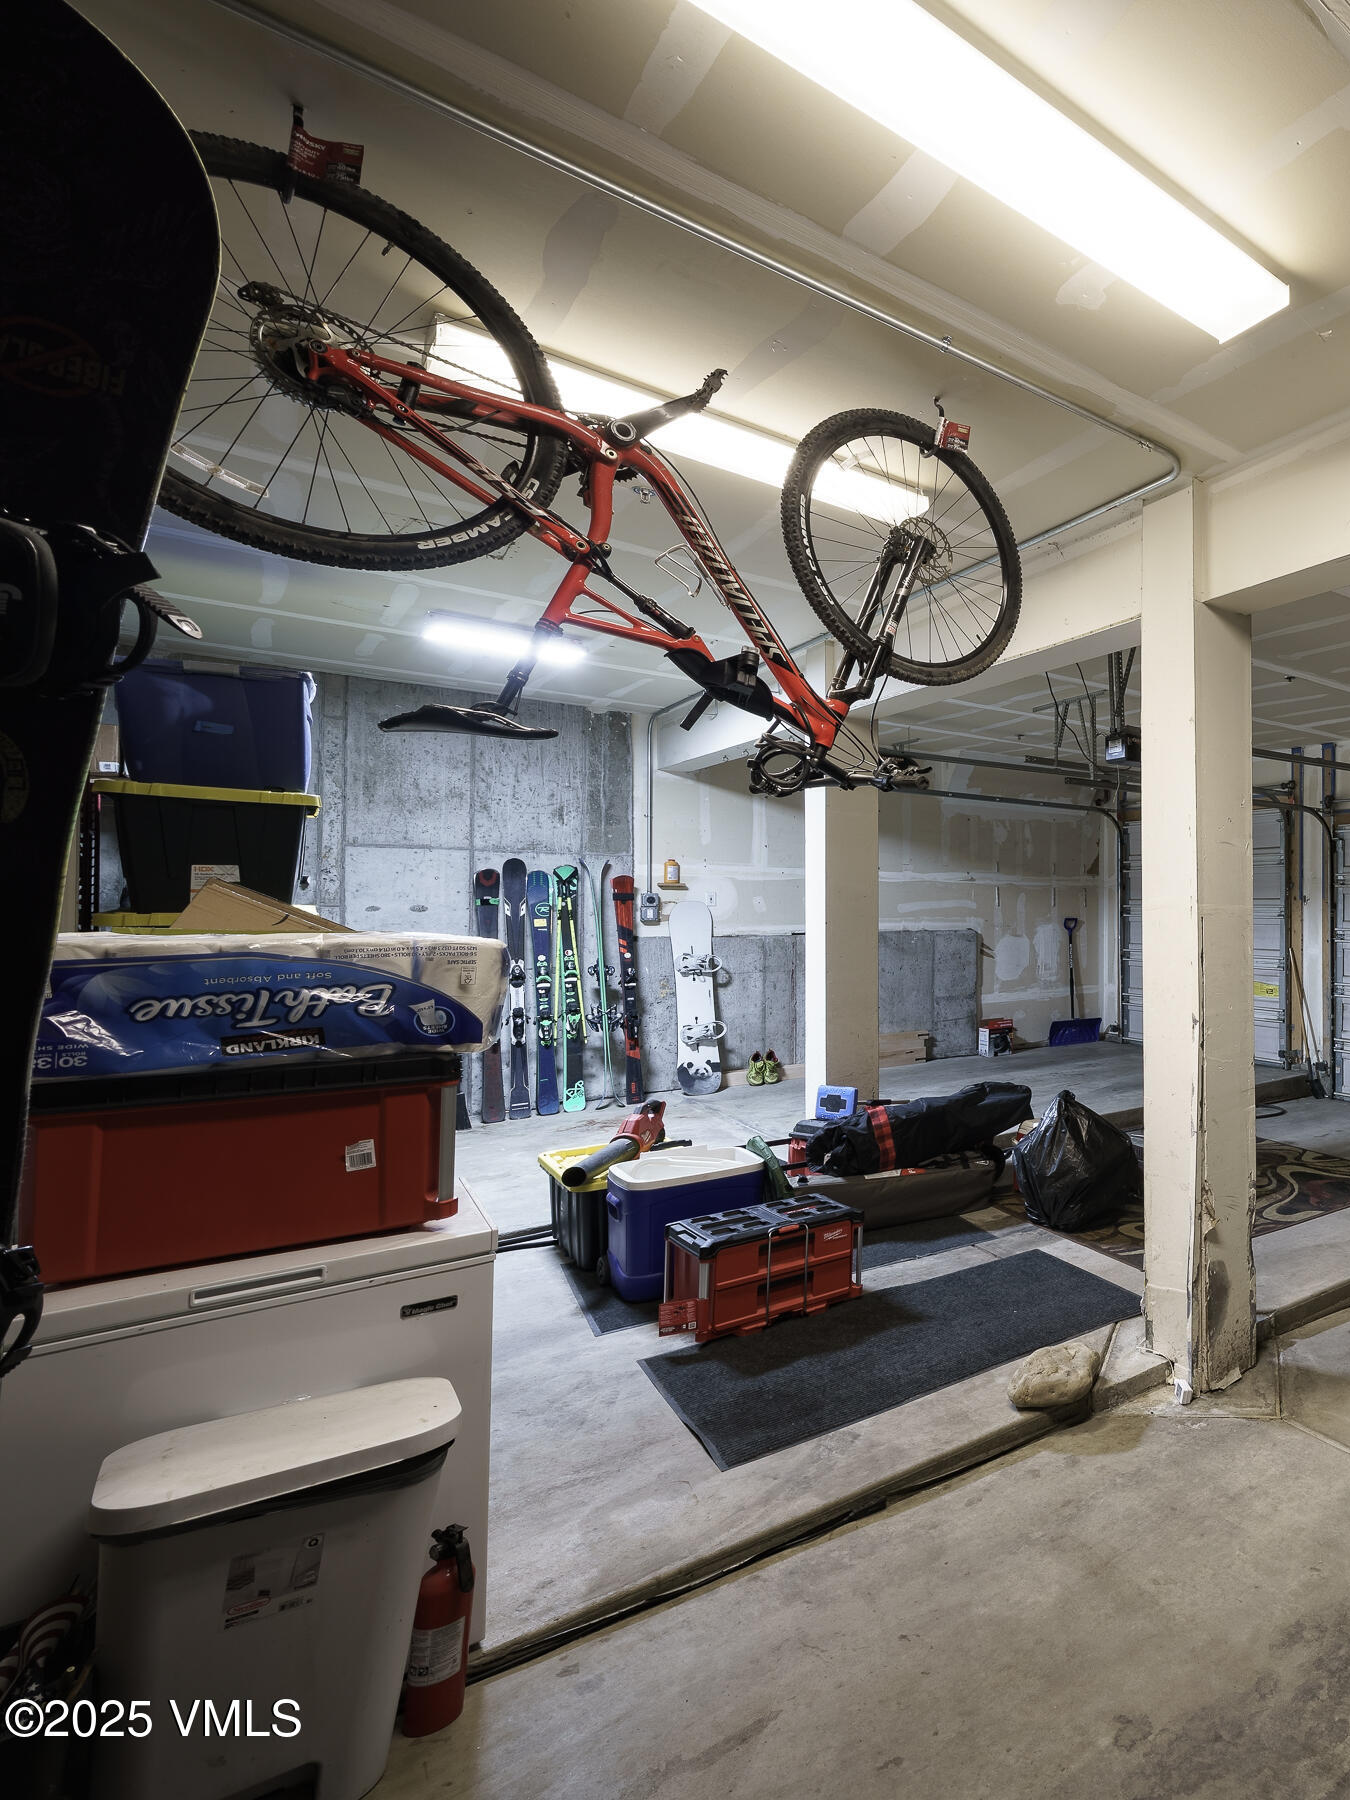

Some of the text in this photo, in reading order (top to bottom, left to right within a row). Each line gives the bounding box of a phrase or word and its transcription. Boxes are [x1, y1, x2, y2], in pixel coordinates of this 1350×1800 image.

[521, 477, 540, 500] CS
[204, 971, 332, 985] Soft and Absorbent
[130, 983, 395, 1028] Bath Tissue
[225, 1034, 320, 1055] KIRKLAND
[58, 1055, 88, 1068] 30
